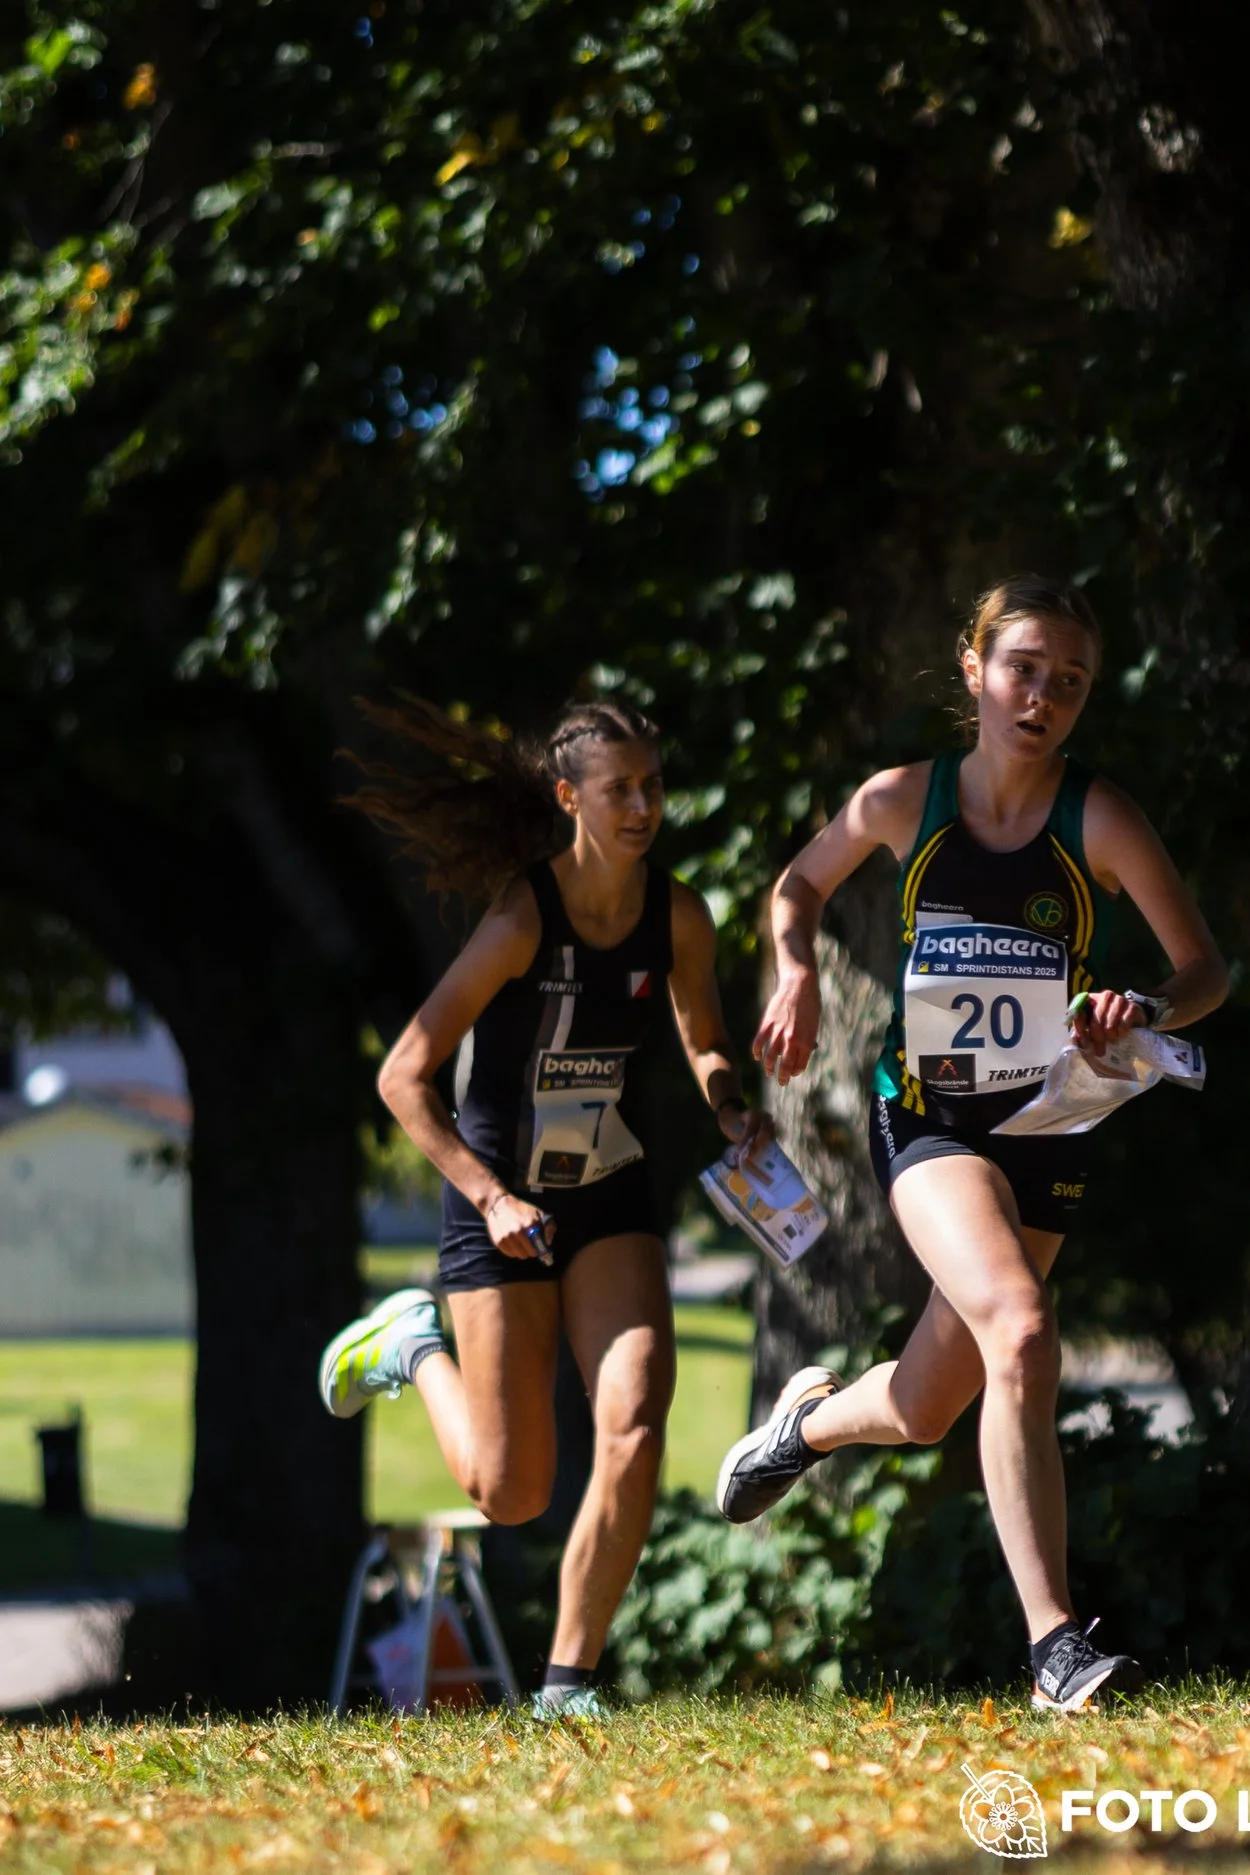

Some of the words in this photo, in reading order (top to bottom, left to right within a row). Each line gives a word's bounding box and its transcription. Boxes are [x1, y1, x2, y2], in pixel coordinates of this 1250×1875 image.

[921, 901, 964, 911] bagheera
[921, 933, 1060, 959] bagheera
[934, 963, 949, 972] SM
[956, 964, 1032, 975] SPRINTDISTANS
[1034, 966, 1057, 976] 2025
[951, 993, 1024, 1049] 20
[988, 1064, 1049, 1082] TRIMTE
[581, 1101, 607, 1150] 7
[1051, 1182, 1087, 1198] SWE
